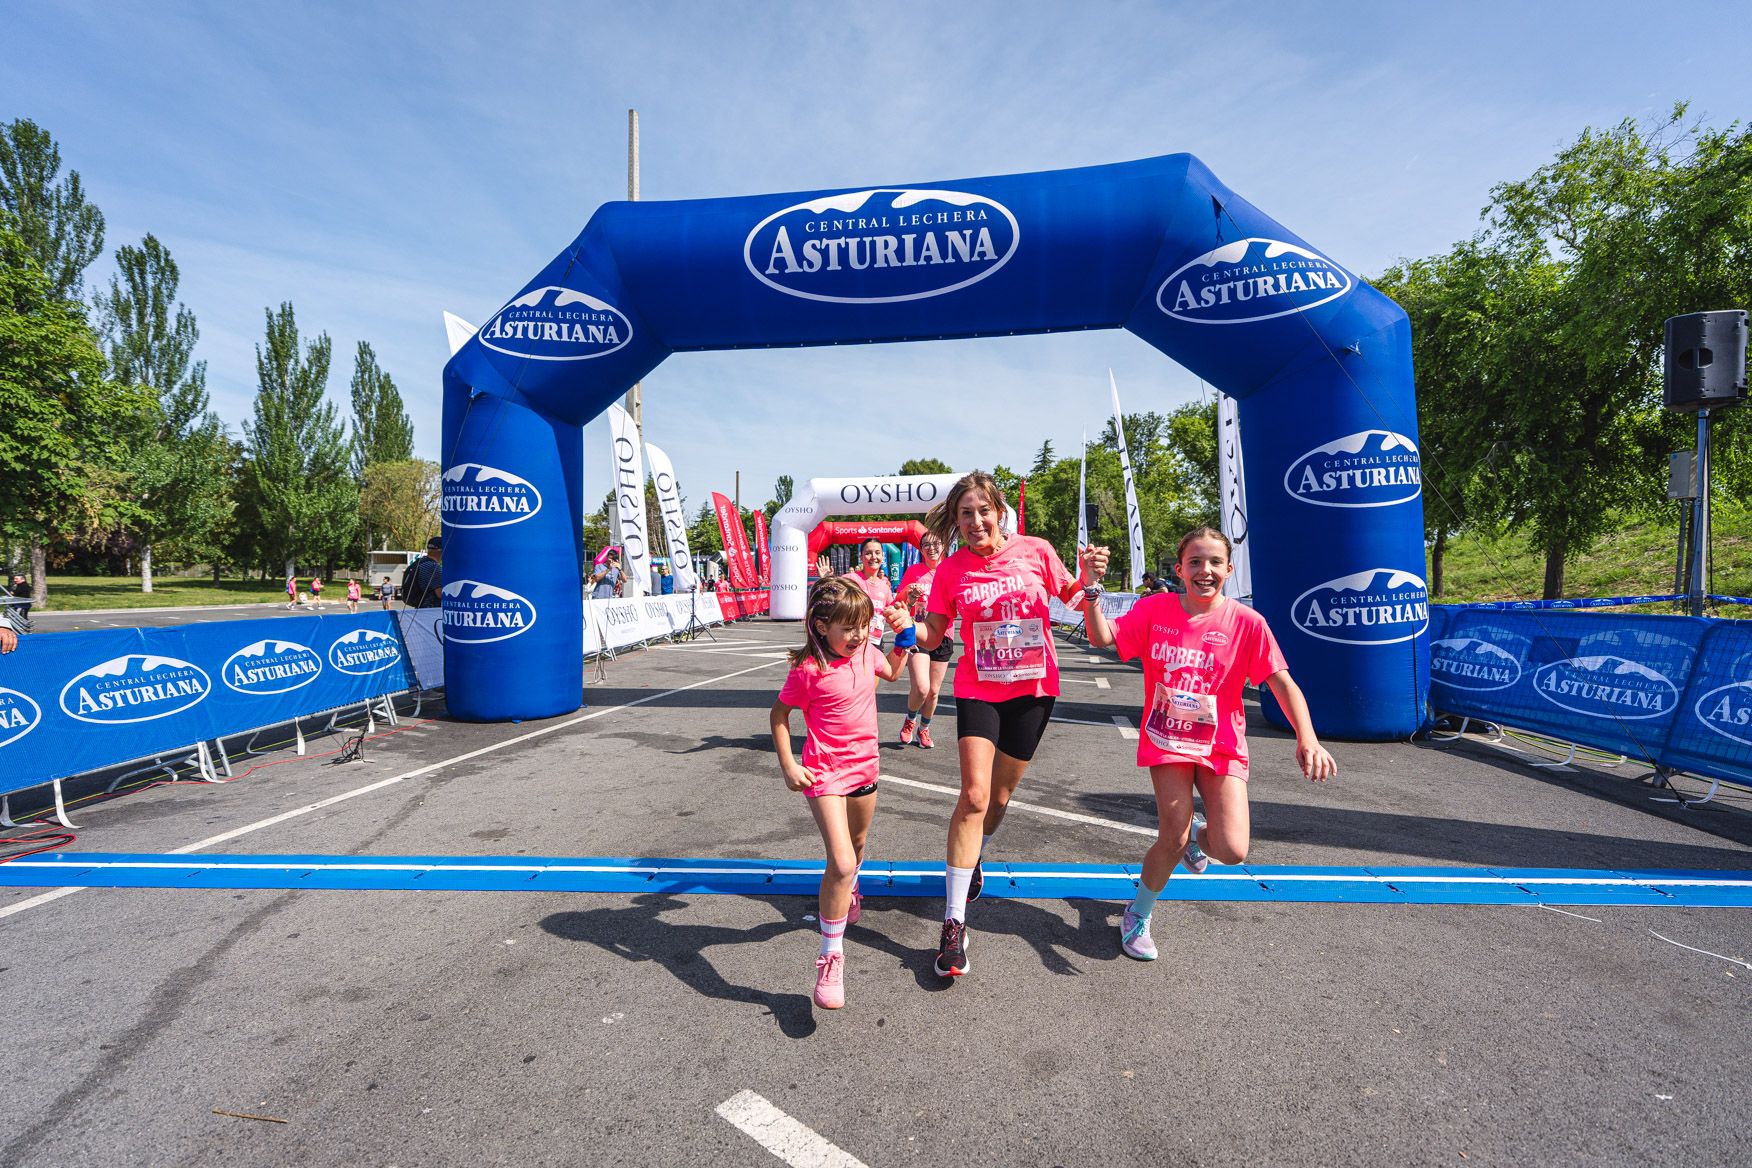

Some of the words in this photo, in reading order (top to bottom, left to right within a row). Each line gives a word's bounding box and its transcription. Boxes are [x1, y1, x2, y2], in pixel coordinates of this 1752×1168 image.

[805, 215, 890, 233] CENTRAL
[899, 209, 988, 227] LECHERA
[765, 225, 999, 275] ASTURIANA
[1201, 265, 1268, 283] CENTRAL
[1273, 260, 1329, 270] LECHERA
[1172, 271, 1343, 312] ASTURIANA
[509, 310, 554, 318] CENTRAL
[558, 311, 614, 322] LECHERA
[484, 314, 621, 344] ASTURIANA
[1324, 456, 1381, 469] CENTRAL
[1297, 464, 1420, 494] ASTURIANA
[479, 486, 526, 494] LECHERA
[840, 481, 938, 504] OYSHO
[784, 506, 814, 515] OYSHO
[835, 526, 858, 536] Sports
[868, 526, 905, 534] Santander
[772, 545, 799, 553] OYSHO
[1330, 594, 1388, 605] CENTRAL
[442, 609, 526, 628] STURIANA
[605, 603, 639, 626] OYSHO
[1303, 599, 1429, 627] ASTURIANA
[1152, 623, 1179, 636] OYSHO
[245, 658, 279, 668] CENTRAL
[996, 648, 1023, 660] 016
[96, 676, 147, 690] CENTRAL
[150, 670, 195, 682] LECHERA
[234, 659, 318, 687] ASTURIANA
[1430, 657, 1510, 683] STURIANA
[1540, 670, 1664, 712] ASTURIANA
[1614, 678, 1665, 692] LECHERA
[78, 678, 204, 715] ASTURIANA
[1166, 717, 1194, 731] 016
